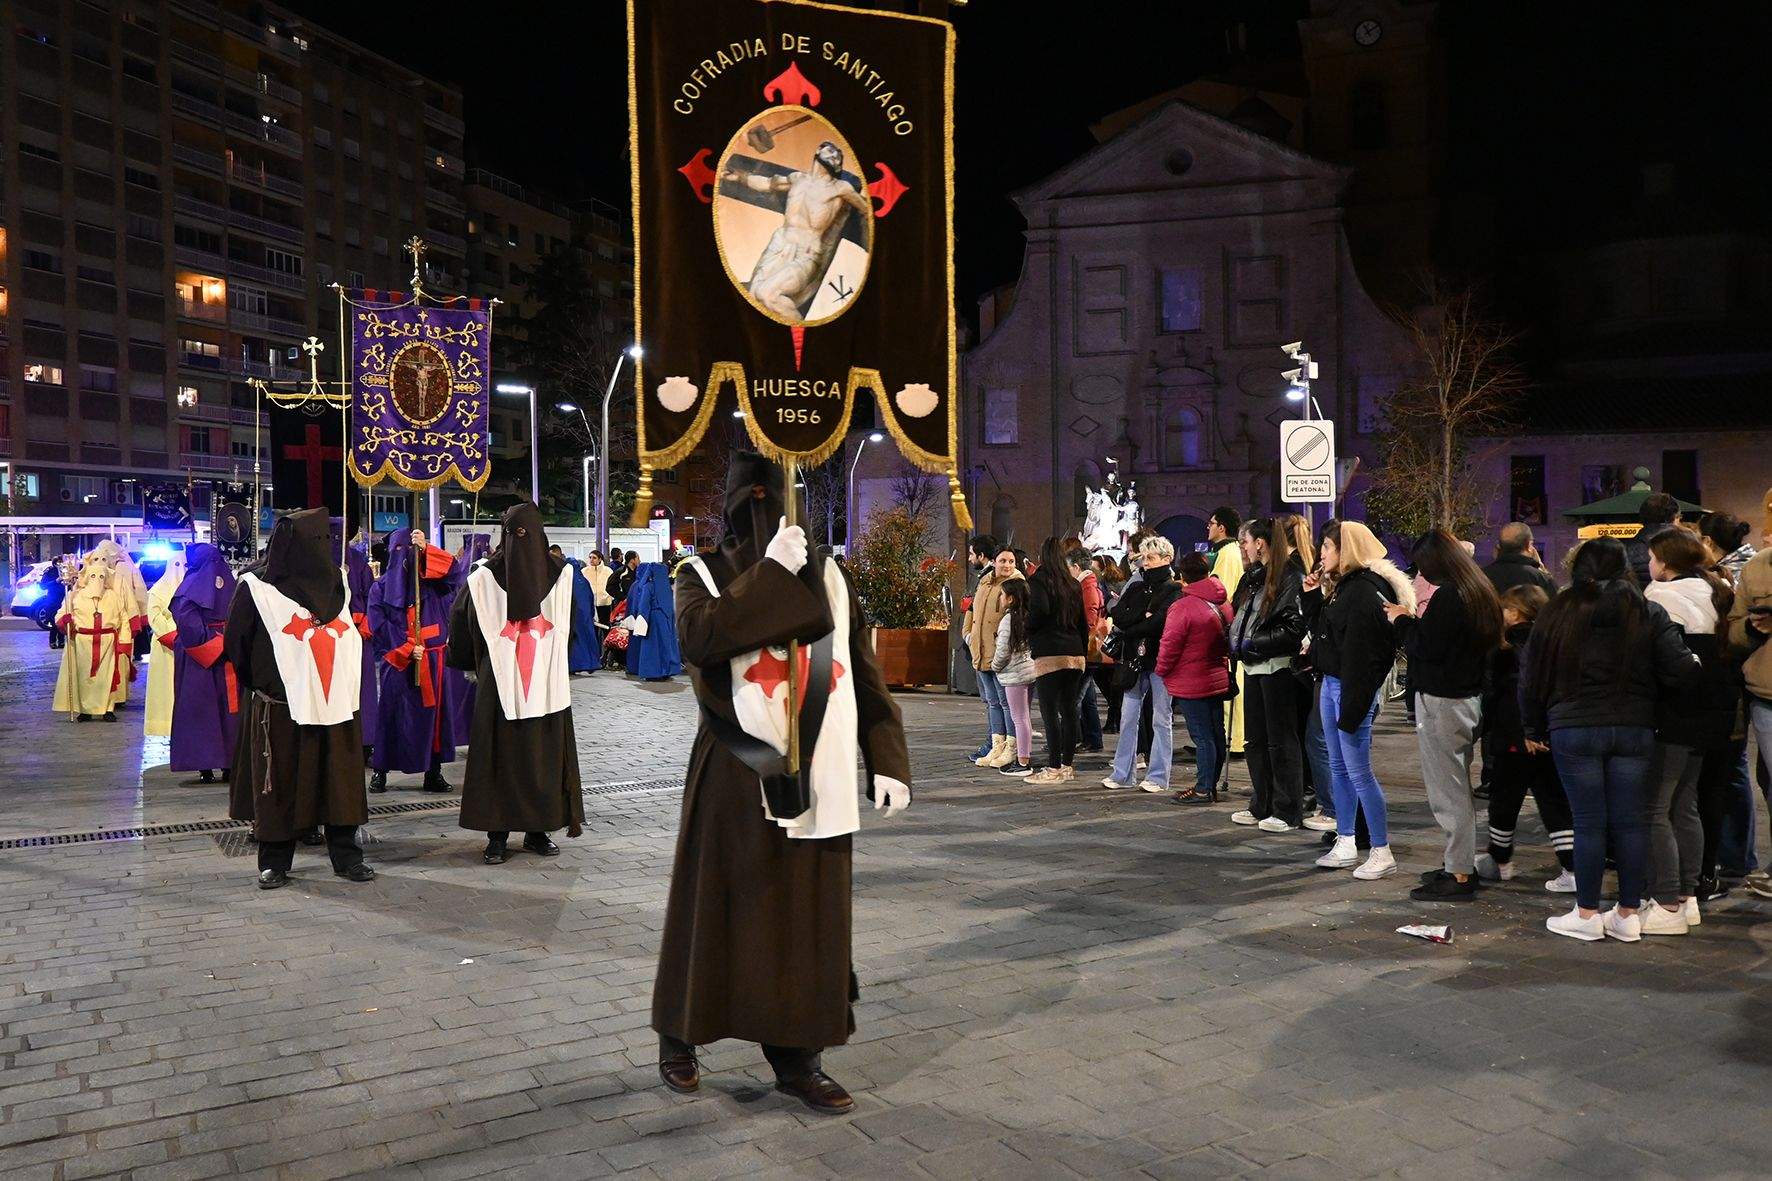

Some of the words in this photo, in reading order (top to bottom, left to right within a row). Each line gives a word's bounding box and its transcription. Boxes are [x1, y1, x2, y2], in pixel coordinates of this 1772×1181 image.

[673, 38, 768, 116] COFRADIA
[781, 32, 811, 54] DE
[822, 41, 914, 137] SANTIAGO
[753, 378, 842, 400] HUESCA
[776, 407, 822, 424] 1956
